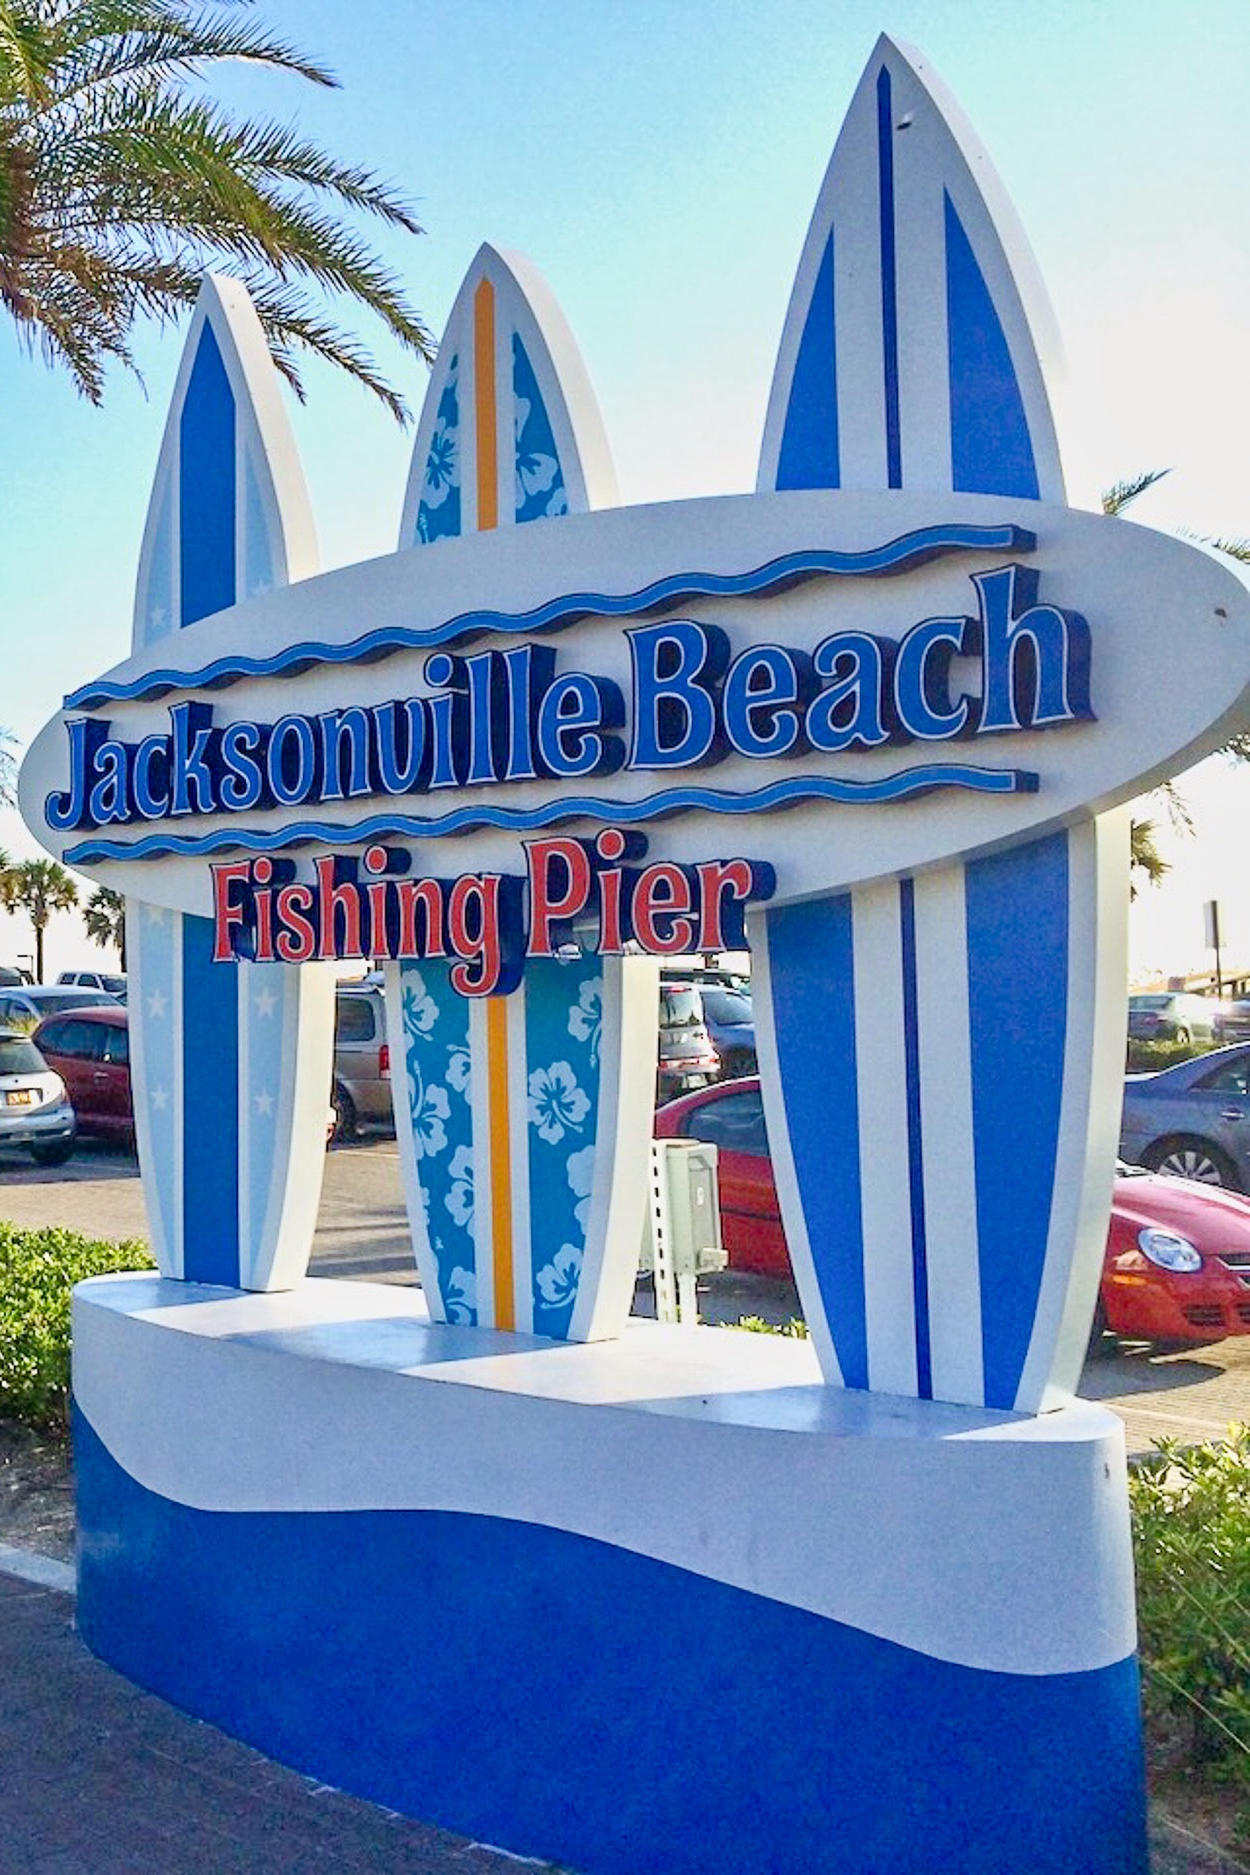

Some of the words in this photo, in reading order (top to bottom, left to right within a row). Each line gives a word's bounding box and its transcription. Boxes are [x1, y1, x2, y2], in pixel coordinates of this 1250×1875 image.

[45, 643, 612, 831] Jacksonville
[626, 563, 1084, 772] Beach
[211, 844, 509, 998] Fishing
[522, 828, 762, 958] Pier
